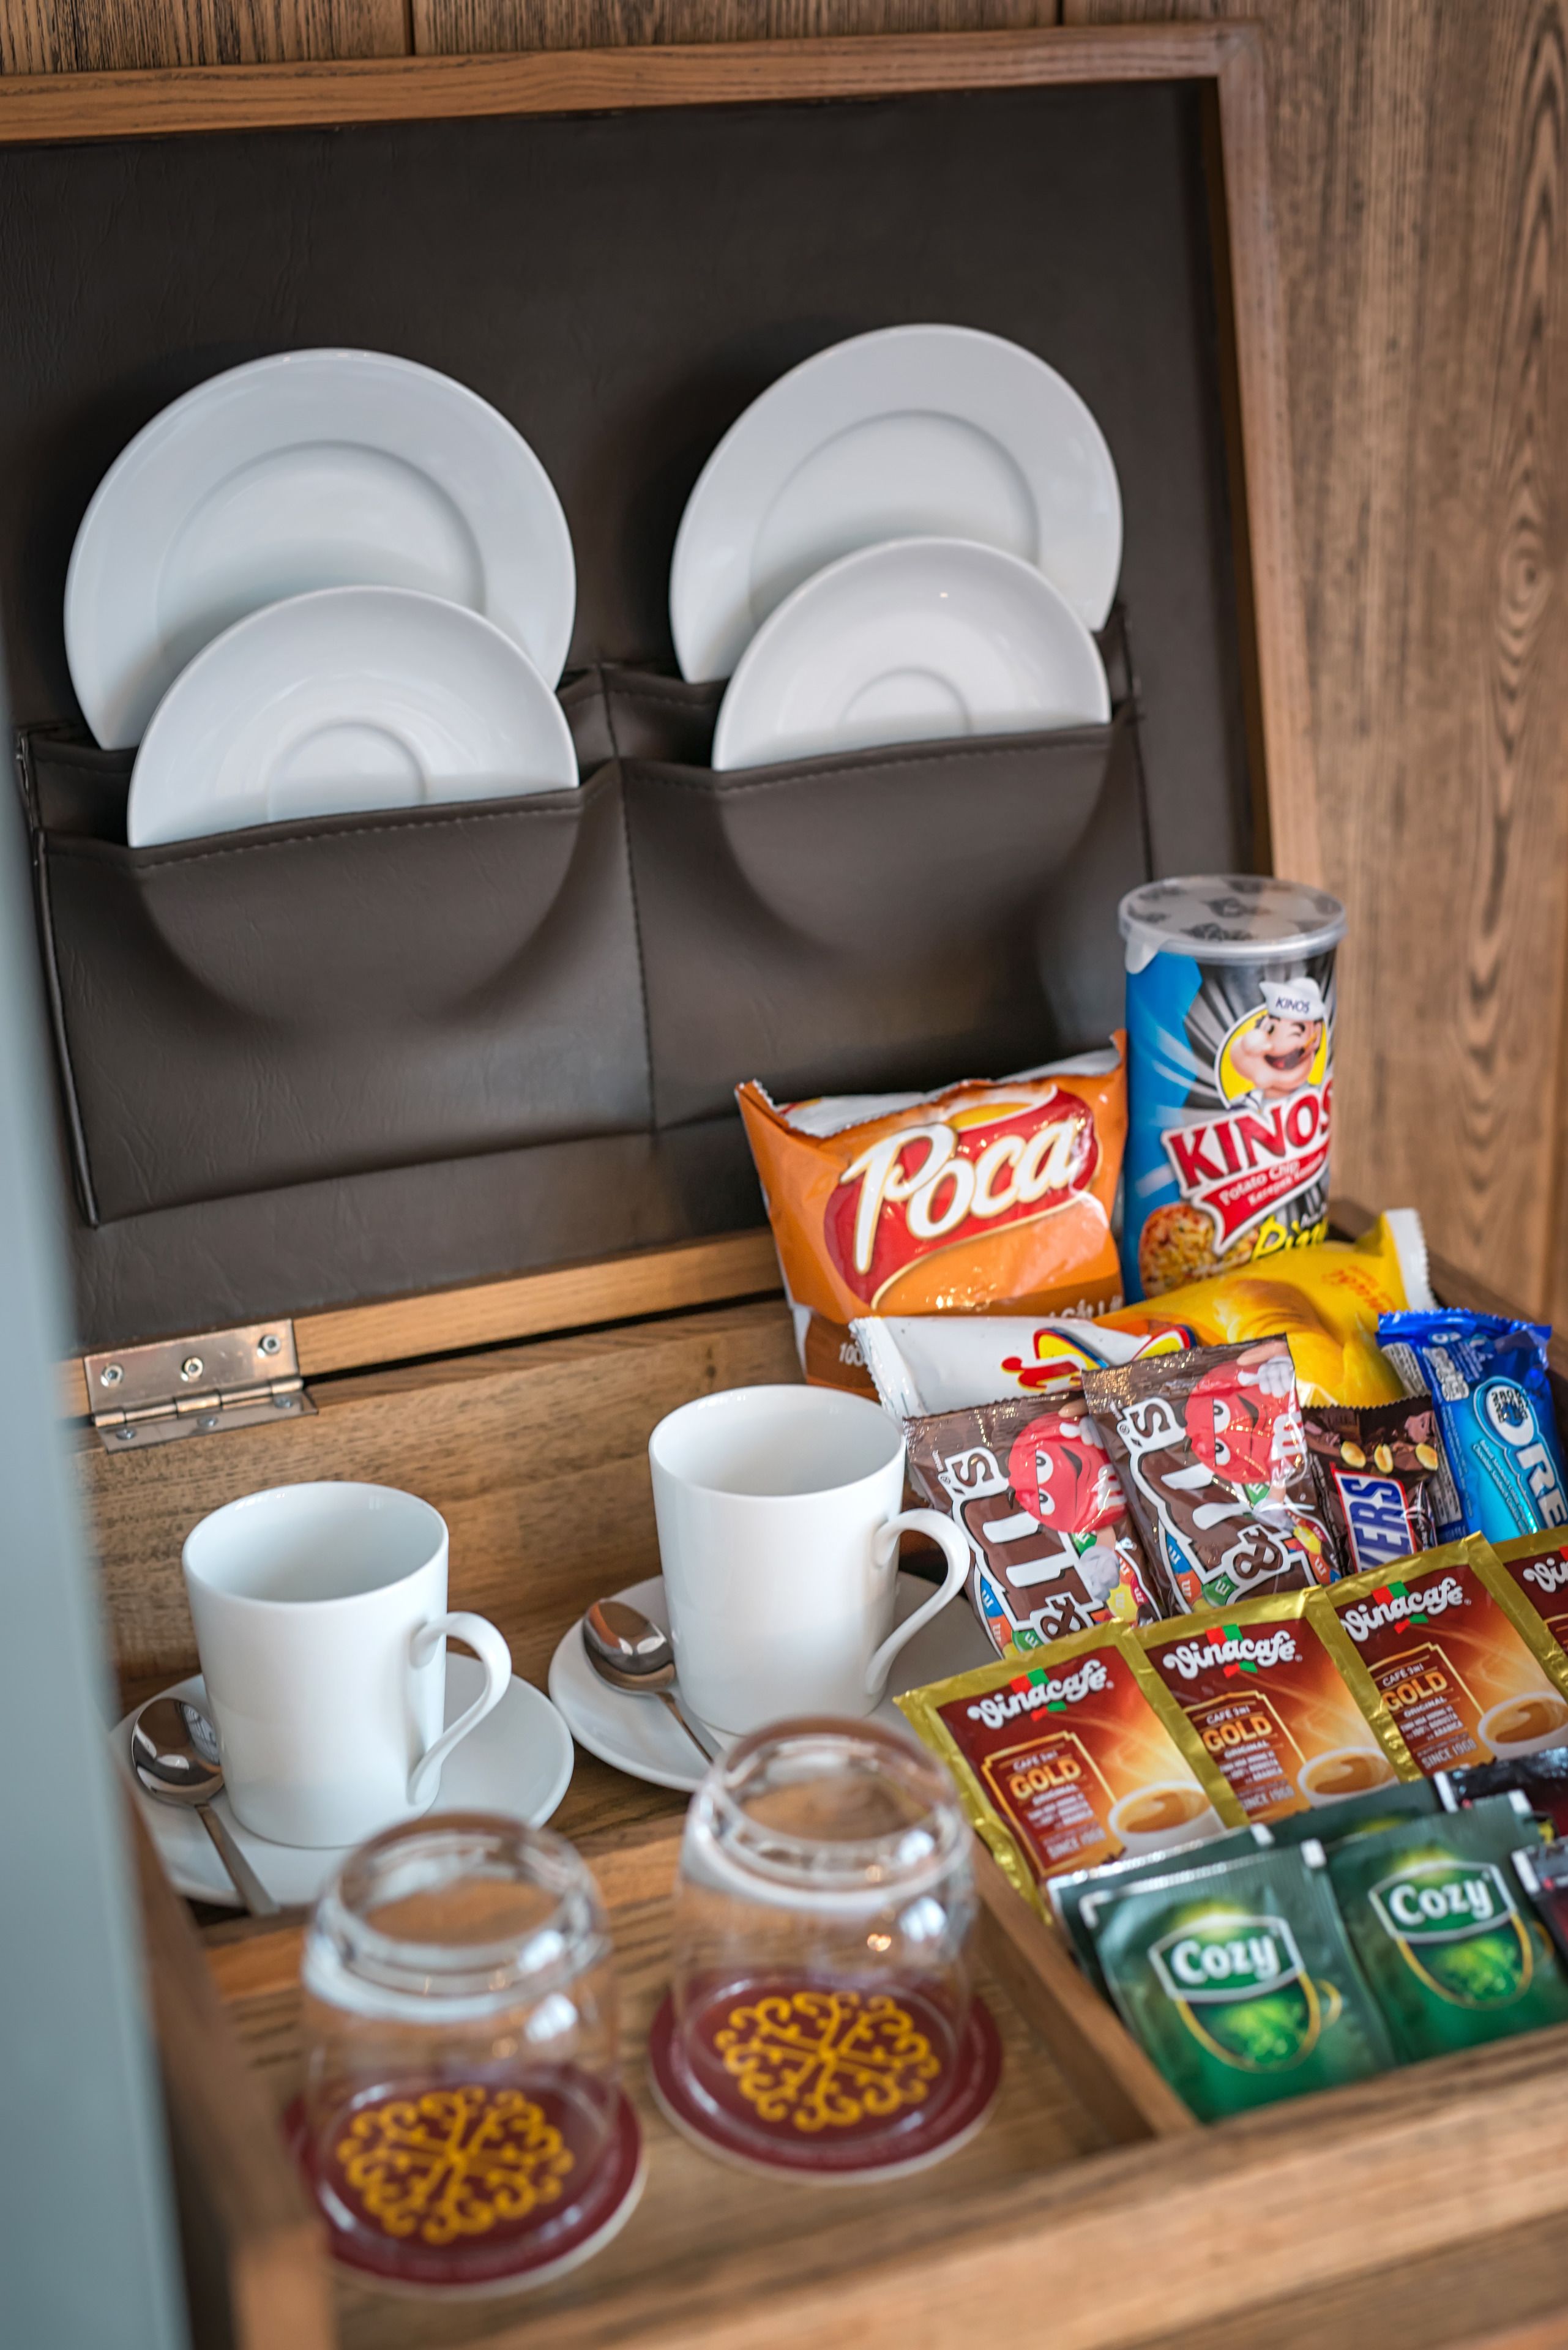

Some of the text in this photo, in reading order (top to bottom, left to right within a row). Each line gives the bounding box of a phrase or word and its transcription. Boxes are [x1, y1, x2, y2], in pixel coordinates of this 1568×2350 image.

[1275, 997, 1310, 1014] KINOS
[1168, 1078, 1332, 1191] KINOS
[839, 1117, 1085, 1275] Poca
[1381, 1671, 1448, 1711] GOLD
[1202, 1716, 1273, 1751] GOLD
[1010, 1758, 1081, 1799] GOLD
[1389, 1877, 1494, 1926] Cozy
[1171, 1933, 1280, 1985] Cozy
